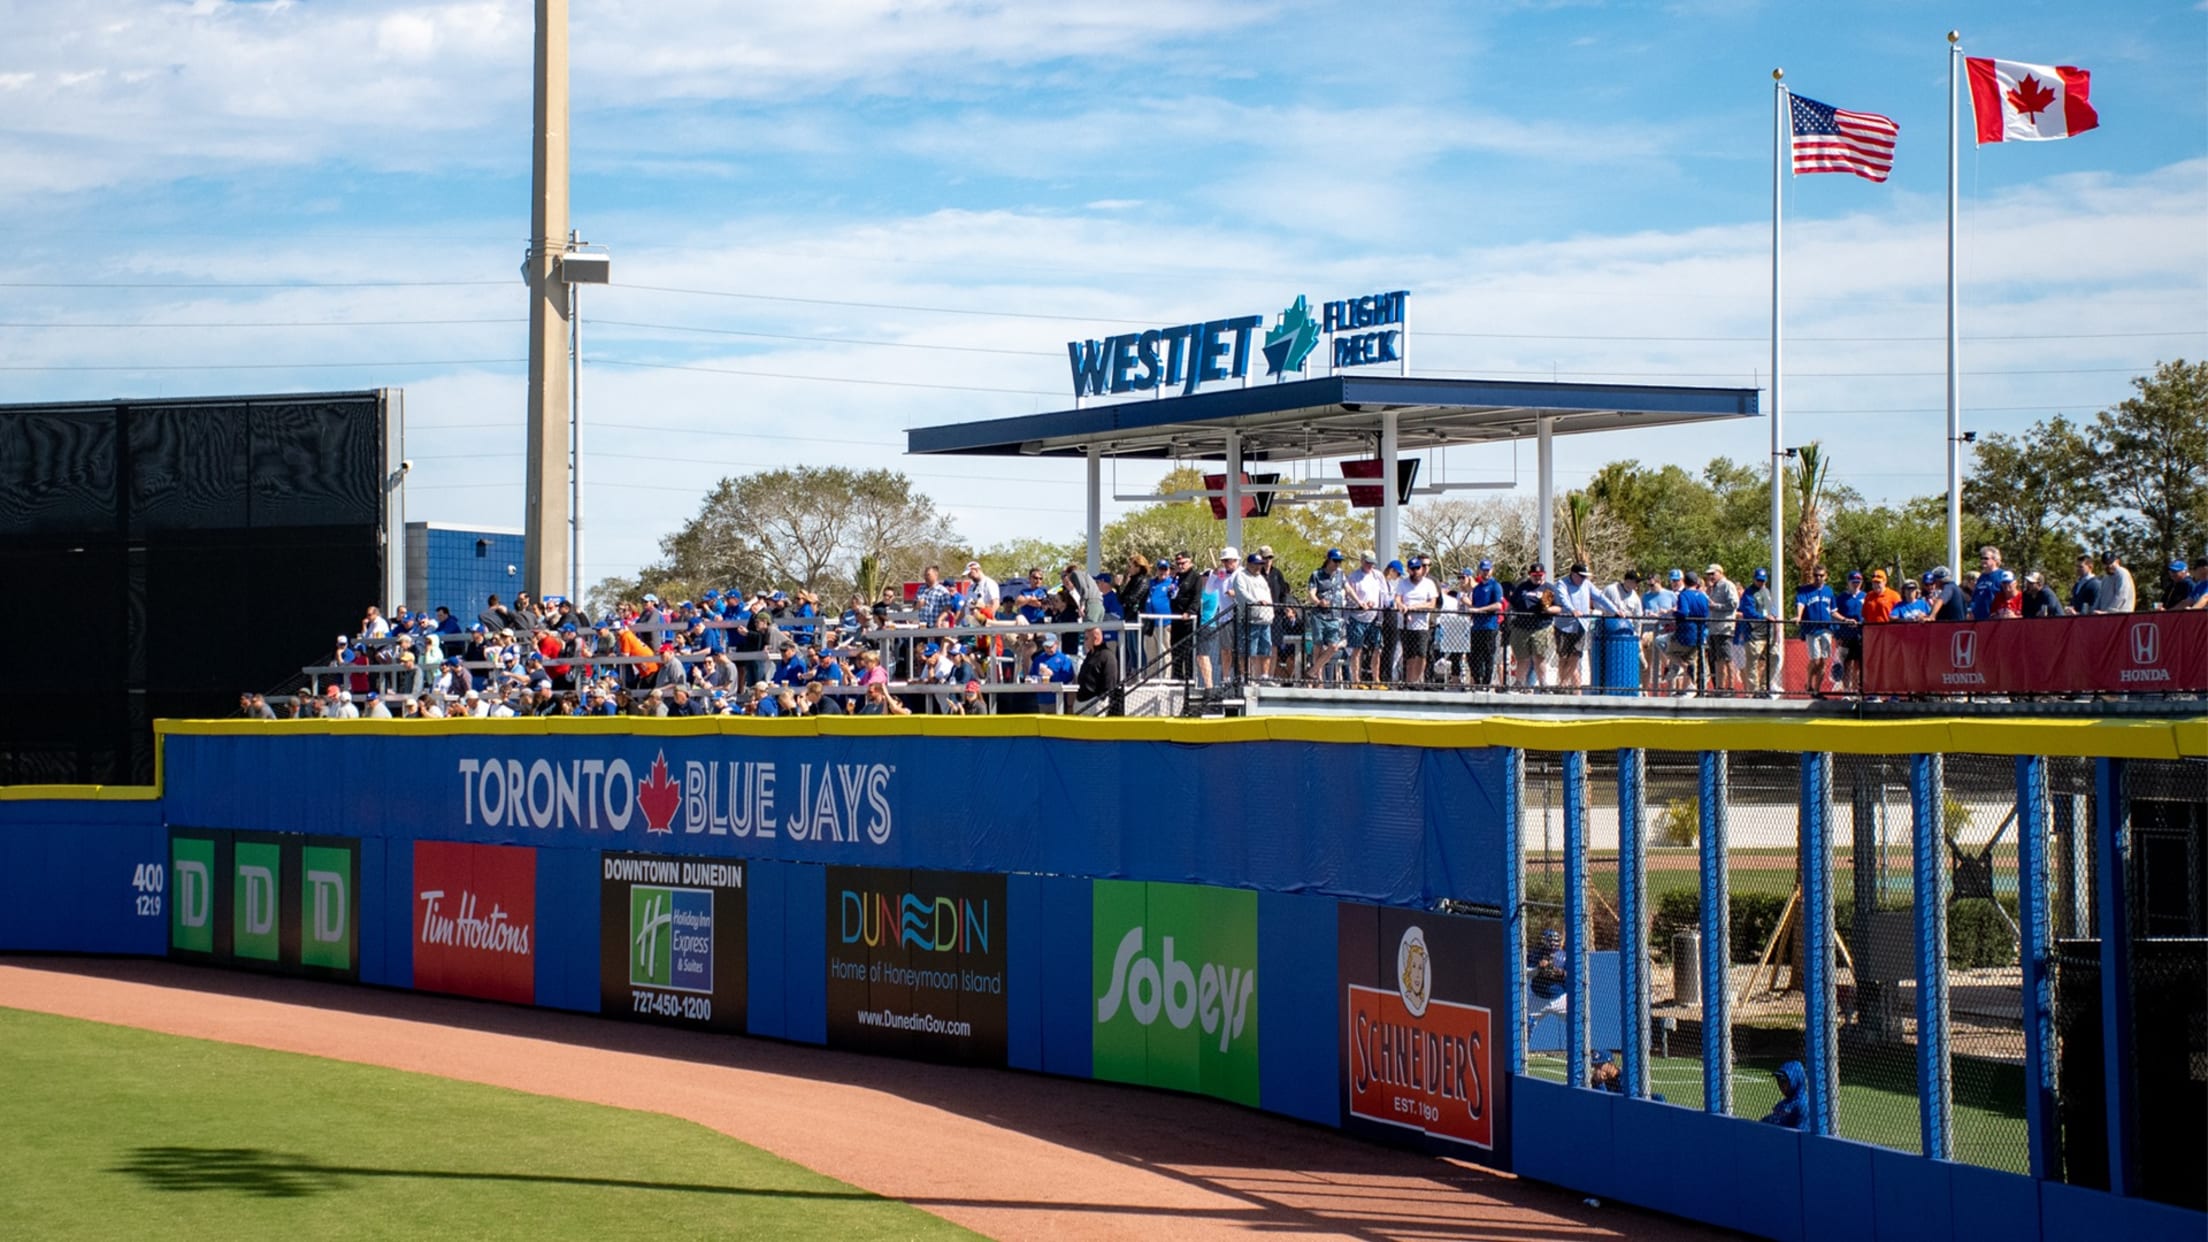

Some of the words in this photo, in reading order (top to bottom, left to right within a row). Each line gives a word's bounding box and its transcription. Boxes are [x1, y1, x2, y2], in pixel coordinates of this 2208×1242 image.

[1323, 291, 1410, 333] FLIGHT
[1068, 315, 1263, 397] WESTJET
[1334, 330, 1399, 367] DECK
[1942, 673, 1986, 684] HONDA
[2120, 669, 2171, 682] HONDA
[459, 758, 634, 832] TORONTO
[685, 760, 777, 838] BLUE
[786, 761, 891, 845] JAYS
[132, 864, 164, 893] 400
[604, 858, 680, 884] DOWNTOWN
[683, 863, 742, 888] DUNEDIN
[176, 860, 209, 928] TD
[239, 865, 274, 935] TD
[307, 870, 345, 942] TD
[420, 890, 454, 946] Tim
[456, 890, 529, 955] Hortons
[673, 909, 699, 930] Holiday
[699, 911, 711, 928] Inn
[841, 890, 989, 955] DUNEDIN
[673, 930, 710, 957] Express
[677, 958, 683, 971] &
[684, 959, 704, 973] Suites
[831, 957, 866, 980] Home
[869, 961, 881, 982] of
[884, 963, 958, 991] Honeymoon
[962, 970, 1001, 994] Island
[632, 990, 712, 1020] 727-450-1200
[1098, 926, 1254, 1053] Sobeys
[857, 1009, 971, 1036] www.DunedinGov.com
[1356, 1009, 1482, 1120] SCHNEIDERS
[1394, 1096, 1417, 1114] EST.
